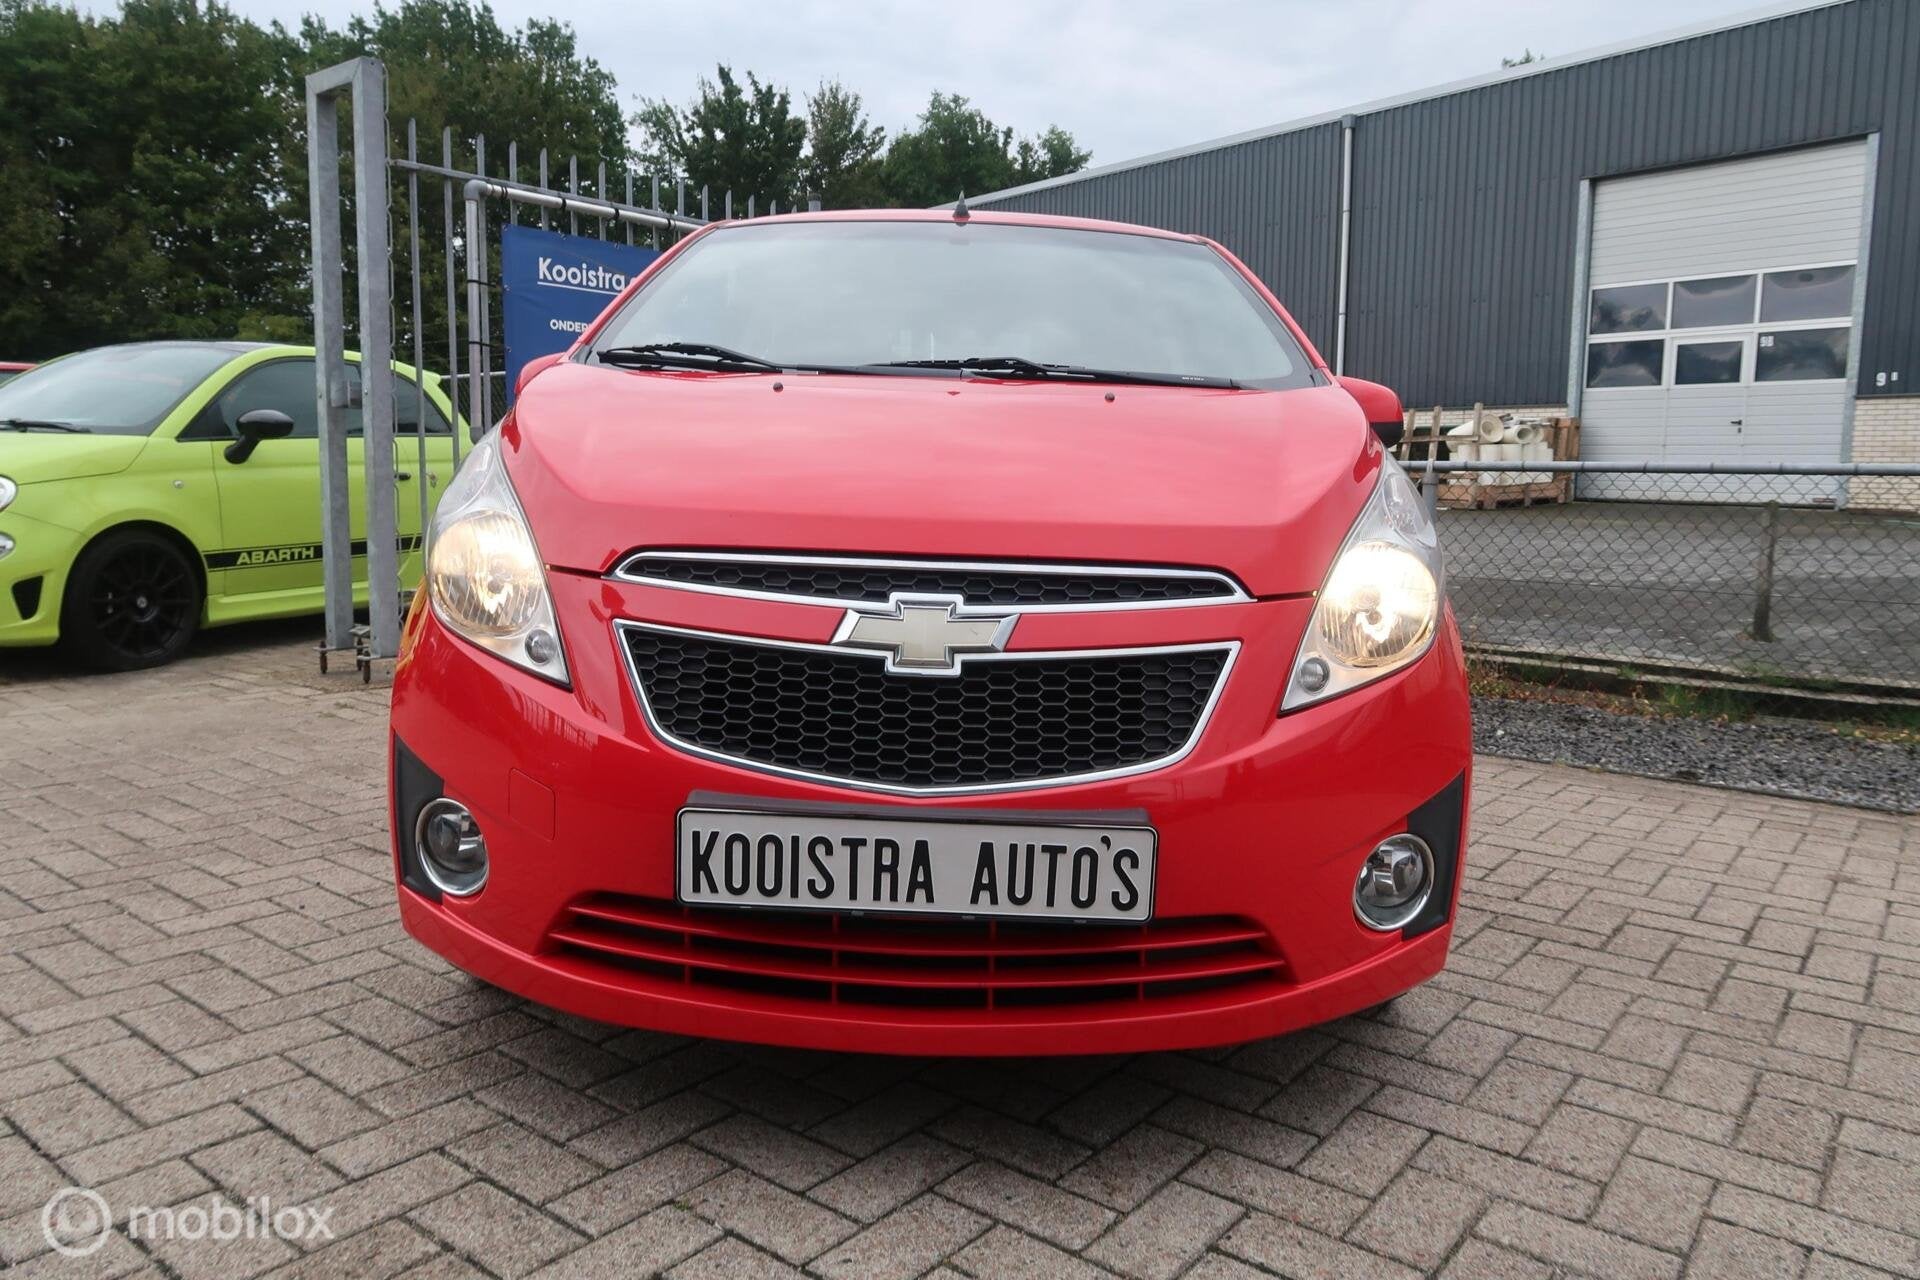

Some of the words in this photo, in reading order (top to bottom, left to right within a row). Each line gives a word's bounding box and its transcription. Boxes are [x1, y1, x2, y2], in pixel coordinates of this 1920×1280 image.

[538, 257, 625, 290] Kooistra
[550, 319, 591, 332] ONDER
[237, 547, 314, 565] ABARTH
[692, 831, 934, 903] KOOISTRA
[970, 835, 1139, 912] AUTO'S
